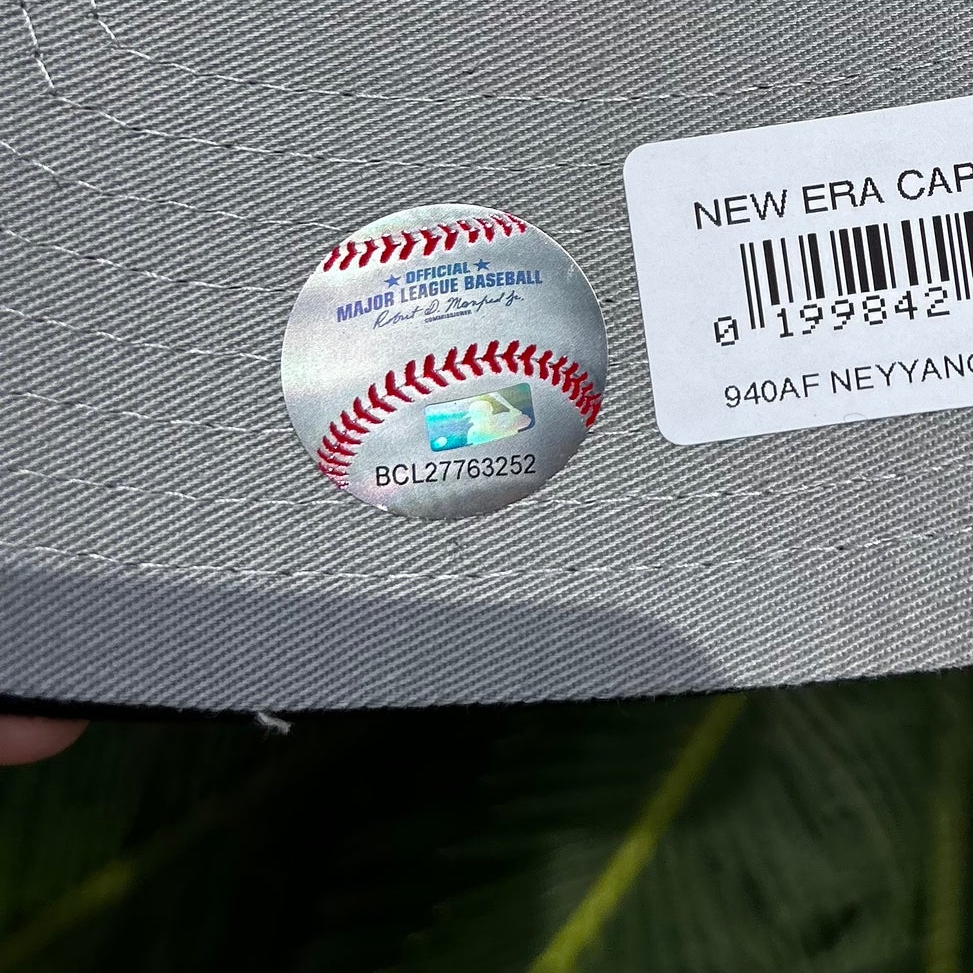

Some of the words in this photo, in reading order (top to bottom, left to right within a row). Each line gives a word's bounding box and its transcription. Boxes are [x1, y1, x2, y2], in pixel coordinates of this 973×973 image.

[694, 189, 788, 230] NEW
[801, 177, 885, 214] ERA
[405, 261, 471, 285] OFFICIAL
[336, 291, 395, 323] MAJOR
[400, 277, 459, 303] LEAGUE
[464, 269, 543, 291] BASEBALL
[714, 316, 738, 347] 0
[776, 286, 950, 338] 199842
[724, 372, 820, 408] 940AF
[375, 453, 537, 488] BCL27763252
